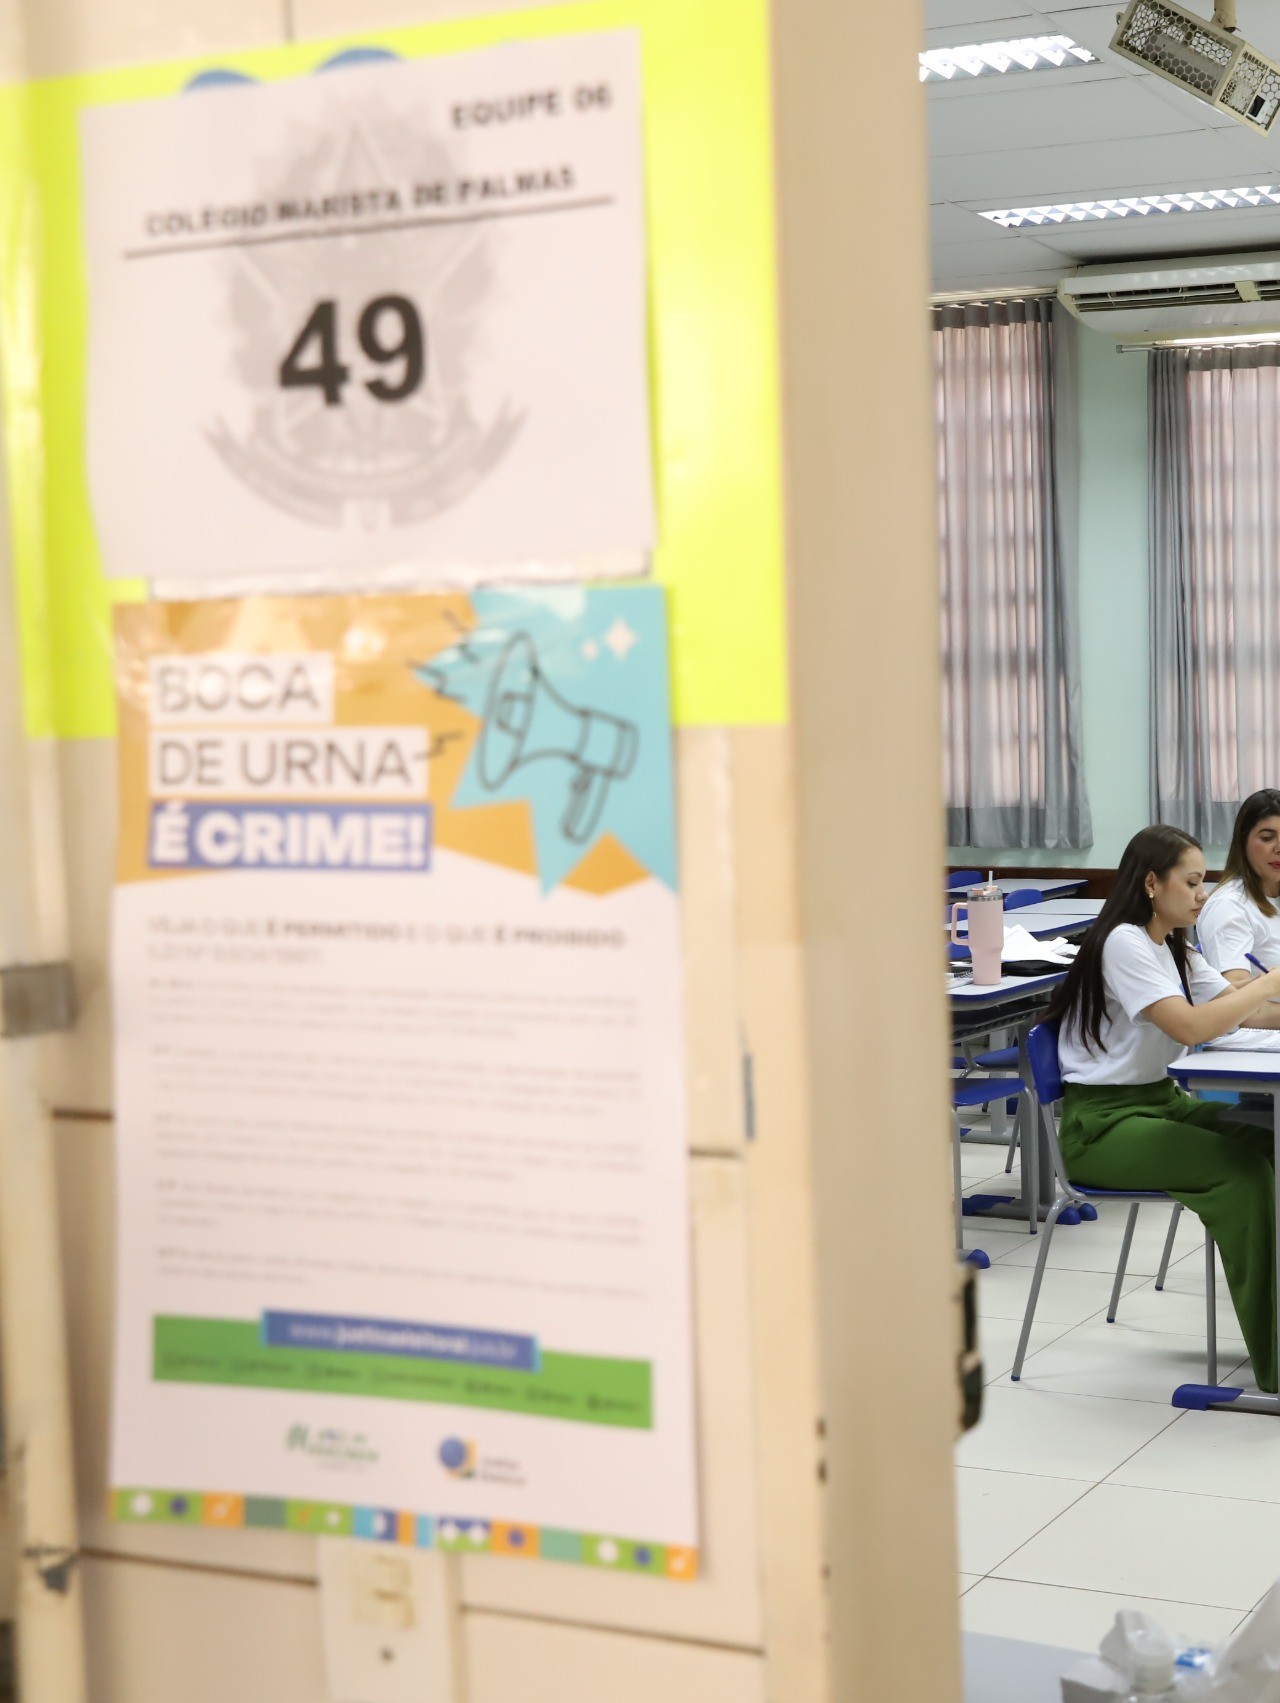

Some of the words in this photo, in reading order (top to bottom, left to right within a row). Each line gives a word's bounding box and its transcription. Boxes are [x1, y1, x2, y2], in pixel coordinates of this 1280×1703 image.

[453, 86, 561, 130] EQUIPE
[276, 186, 401, 223] MARISTA
[413, 180, 446, 207] DE
[456, 164, 576, 202] PALMAS
[277, 292, 428, 409] 49
[158, 661, 322, 714] BOCA
[158, 739, 225, 787] DE
[239, 739, 413, 787] URNA
[153, 800, 191, 864] É
[196, 810, 427, 865] CRIME!
